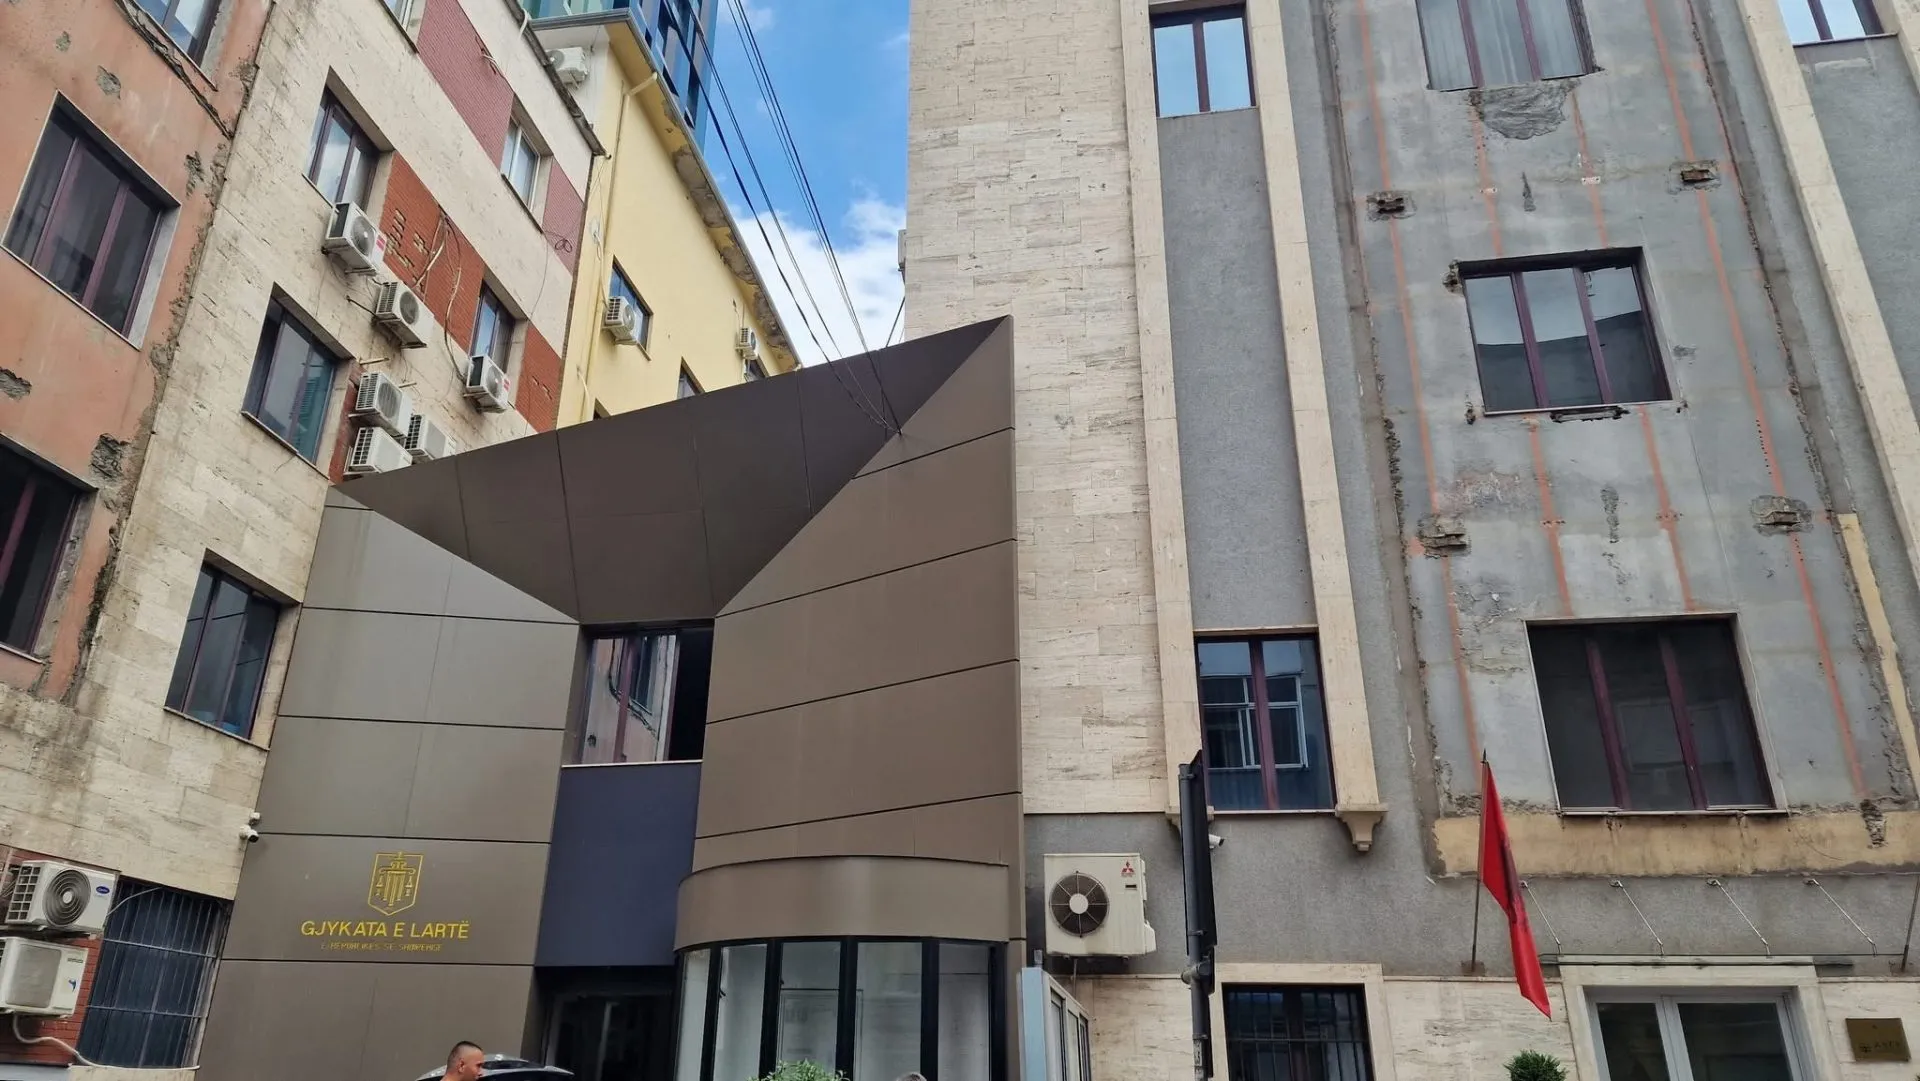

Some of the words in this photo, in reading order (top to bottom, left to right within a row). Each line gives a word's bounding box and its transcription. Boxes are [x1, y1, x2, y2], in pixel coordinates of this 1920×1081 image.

[301, 920, 388, 937] GJYKATA
[393, 922, 406, 938] E
[410, 920, 470, 939] LARTË
